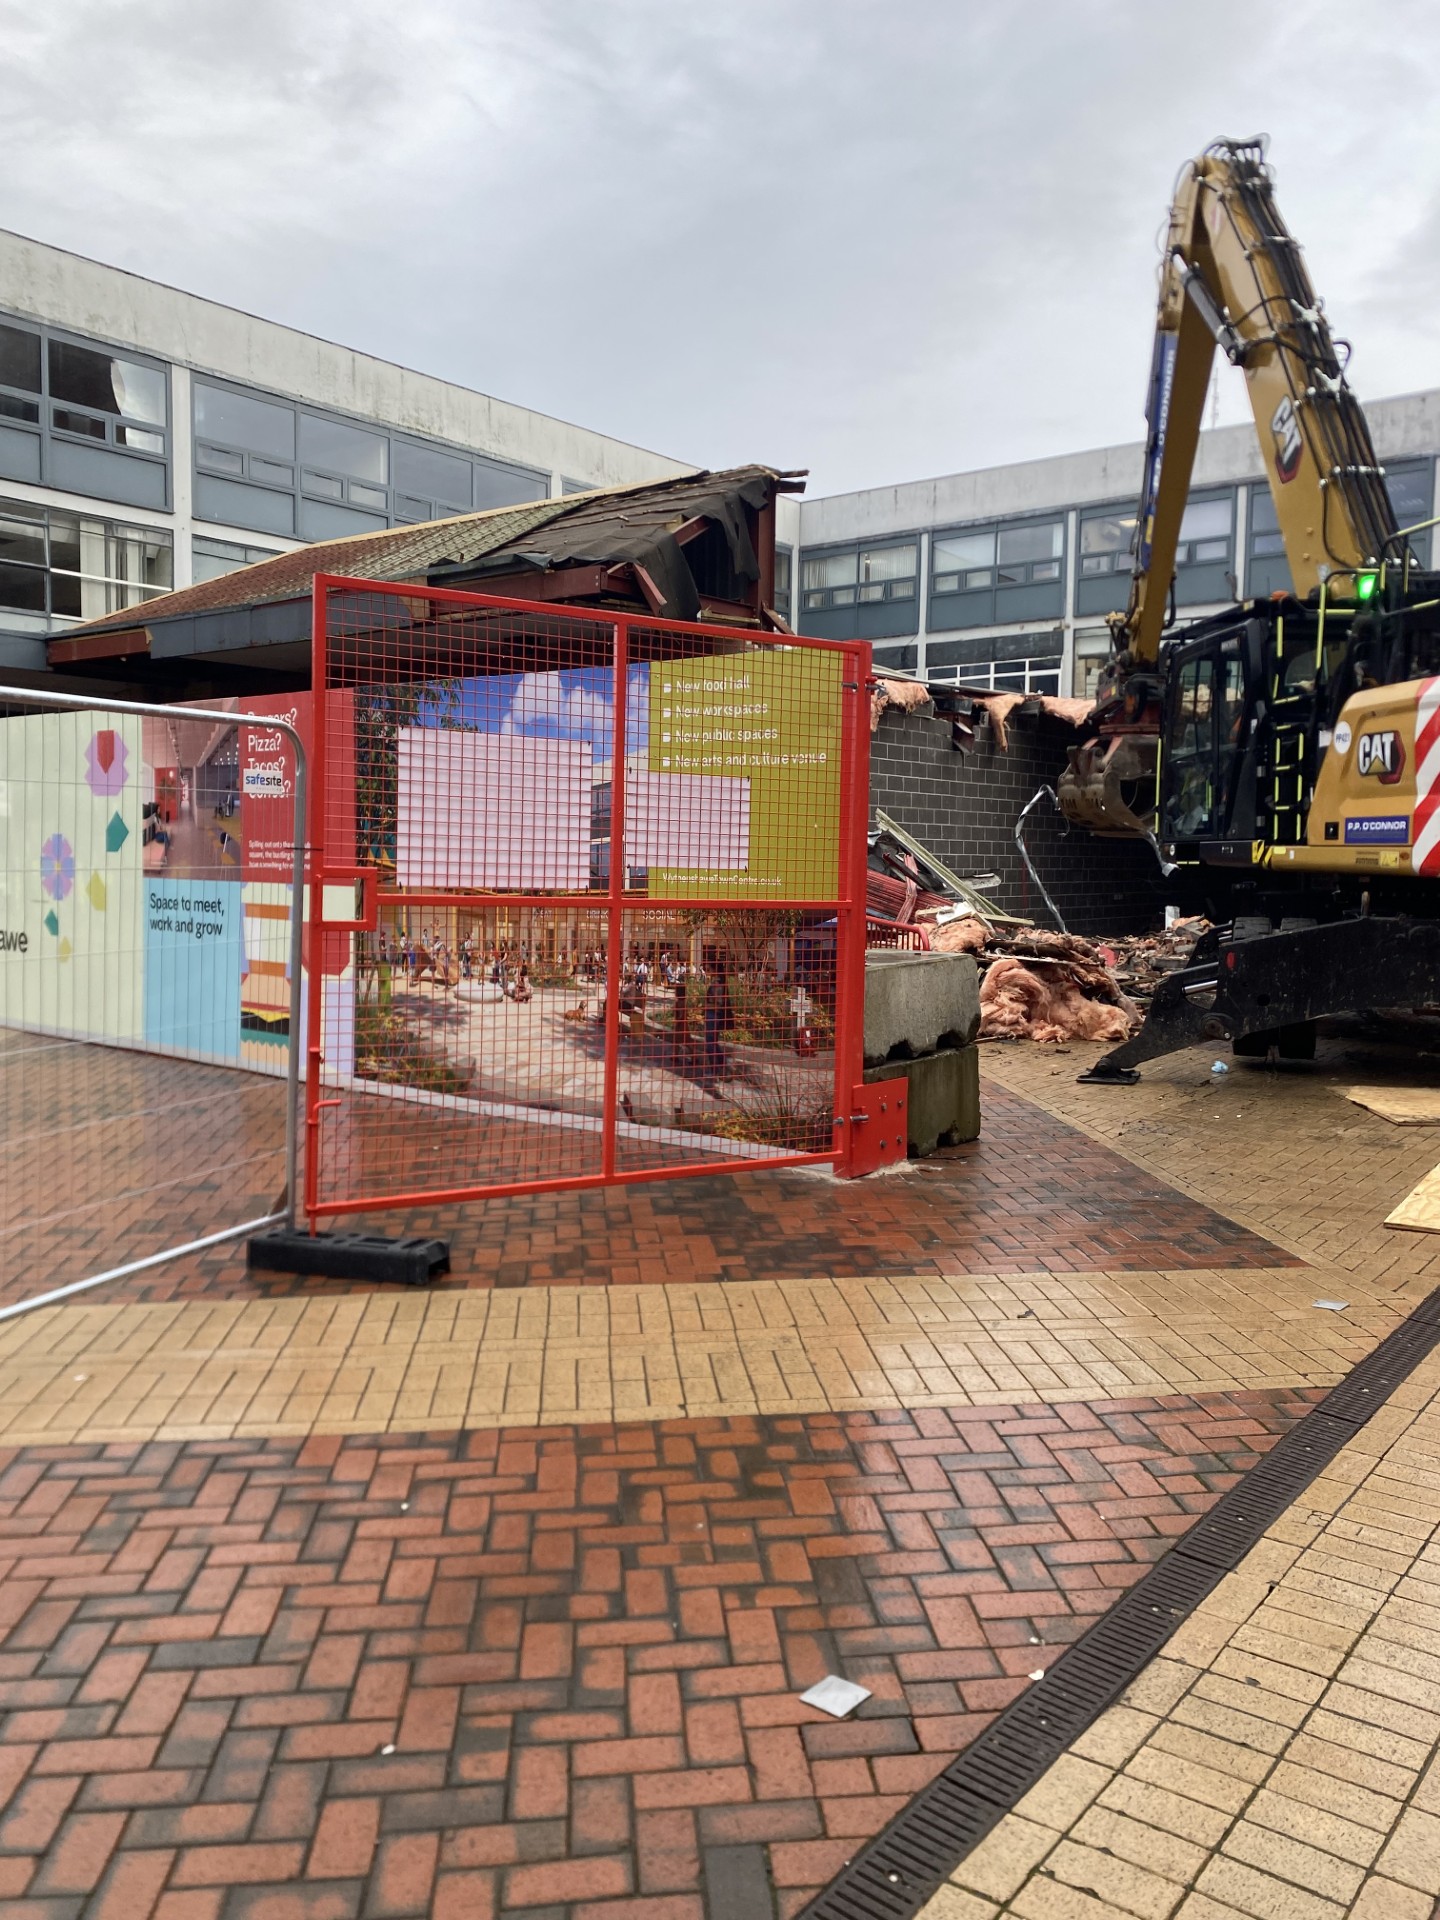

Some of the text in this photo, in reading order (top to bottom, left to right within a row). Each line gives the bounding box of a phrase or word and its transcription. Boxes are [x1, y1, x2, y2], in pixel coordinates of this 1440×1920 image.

[676, 674, 750, 693] New food hall
[675, 702, 768, 718] New workspaces
[247, 732, 282, 752] Pizza?
[675, 728, 778, 745] New public spaces
[675, 751, 827, 768] New arts and culture venue
[1359, 732, 1395, 774] CAT
[245, 774, 282, 787] safesite
[1362, 820, 1407, 831] O'CONNOR
[150, 892, 224, 917] Space to meet,
[150, 916, 223, 939] work and grow
